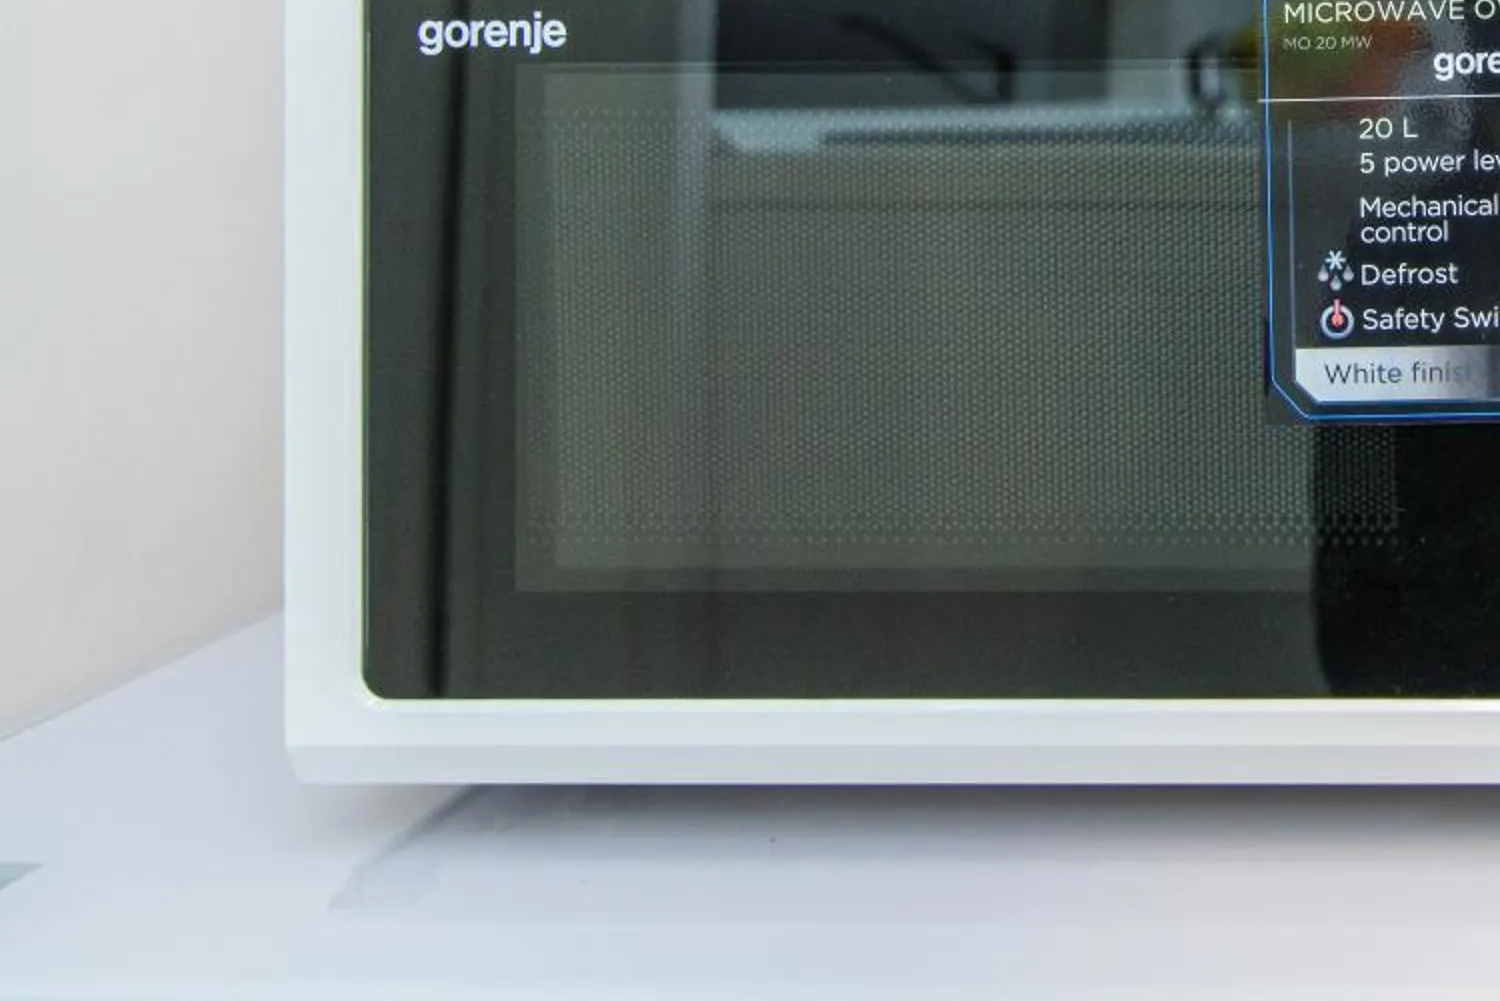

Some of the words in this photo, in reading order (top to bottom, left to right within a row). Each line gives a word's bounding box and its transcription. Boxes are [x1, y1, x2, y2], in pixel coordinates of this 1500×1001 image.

[1284, 0, 1465, 23] MICROWAVE
[418, 11, 567, 55] gorenje
[1283, 37, 1311, 50] MO
[1315, 36, 1337, 50] 20
[1341, 35, 1373, 49] MW
[1359, 118, 1393, 140] 20
[1403, 117, 1418, 138] L
[1360, 153, 1375, 174] 5
[1384, 152, 1465, 177] power
[1360, 194, 1499, 218] Mechanical
[1361, 220, 1449, 243] control
[1361, 263, 1459, 287] Defrost
[1363, 307, 1446, 334] Safety
[1325, 363, 1402, 384] White
